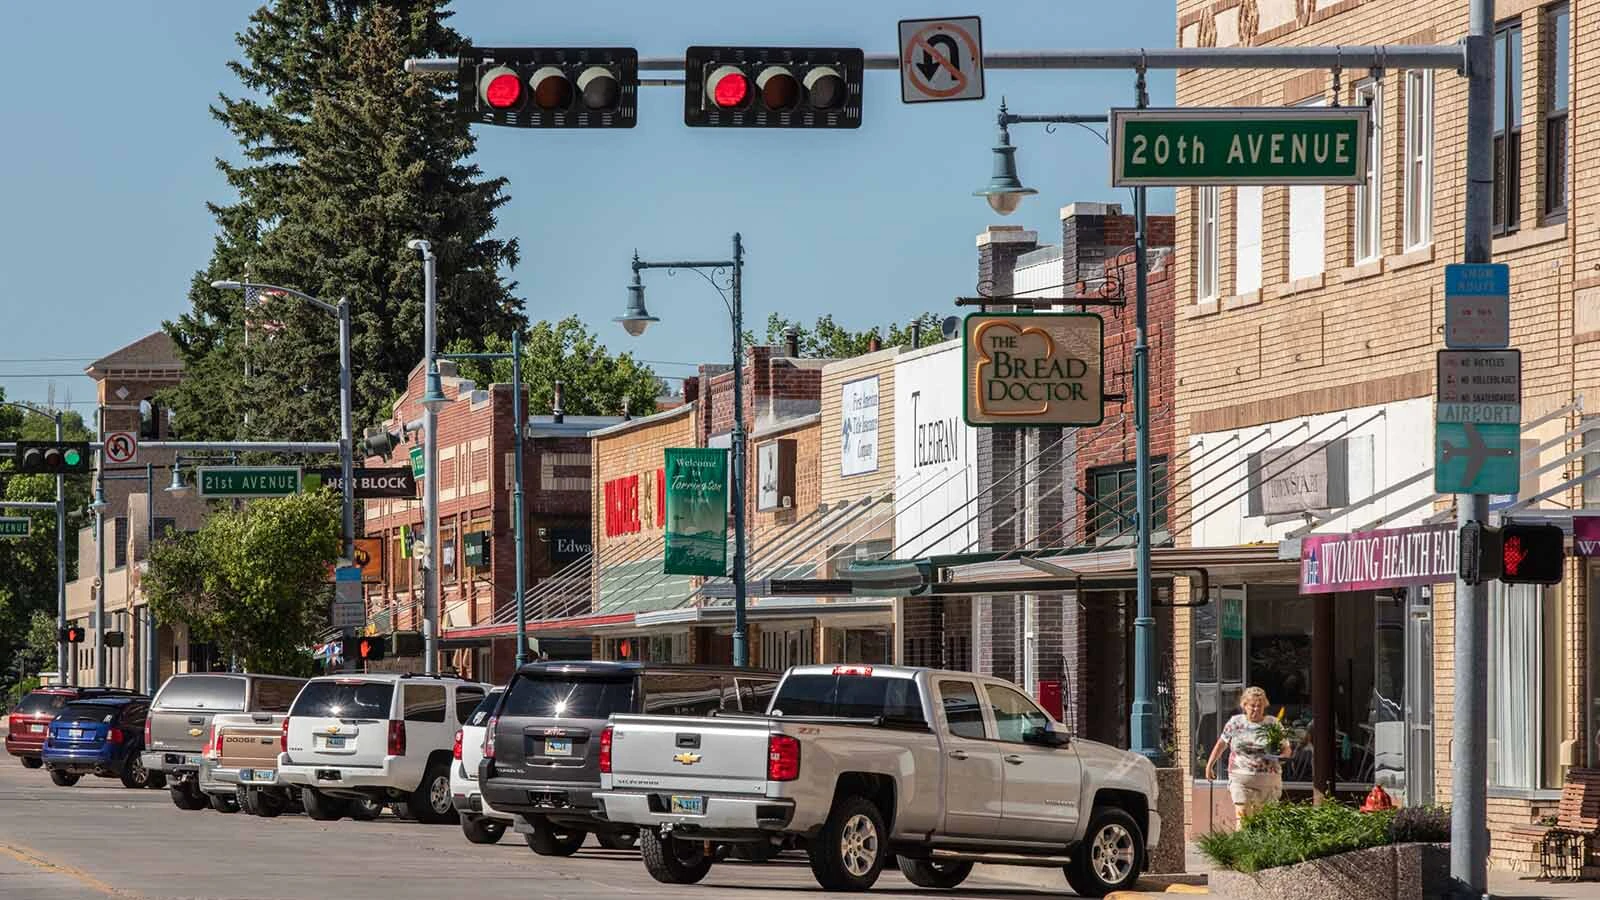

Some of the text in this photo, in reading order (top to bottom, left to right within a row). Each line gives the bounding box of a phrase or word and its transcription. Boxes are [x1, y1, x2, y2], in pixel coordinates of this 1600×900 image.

[1131, 133, 1350, 165] 20th AVENUE
[990, 336, 1017, 348] THE
[993, 351, 1088, 379] BREAD
[988, 380, 1089, 401] DOCTOR
[1446, 405, 1513, 420] AIRPORT
[911, 390, 958, 468] TELEGRAM
[676, 458, 717, 467] Welcome
[206, 475, 294, 489] 21st AVENUE
[362, 477, 407, 489] BLOCK
[671, 474, 722, 491] Torrington
[0, 522, 27, 533] VENUE
[558, 538, 592, 553] Edwa
[1321, 537, 1380, 585] WYOMING
[1381, 532, 1432, 579] HEALTH
[226, 736, 256, 744] DODGE
